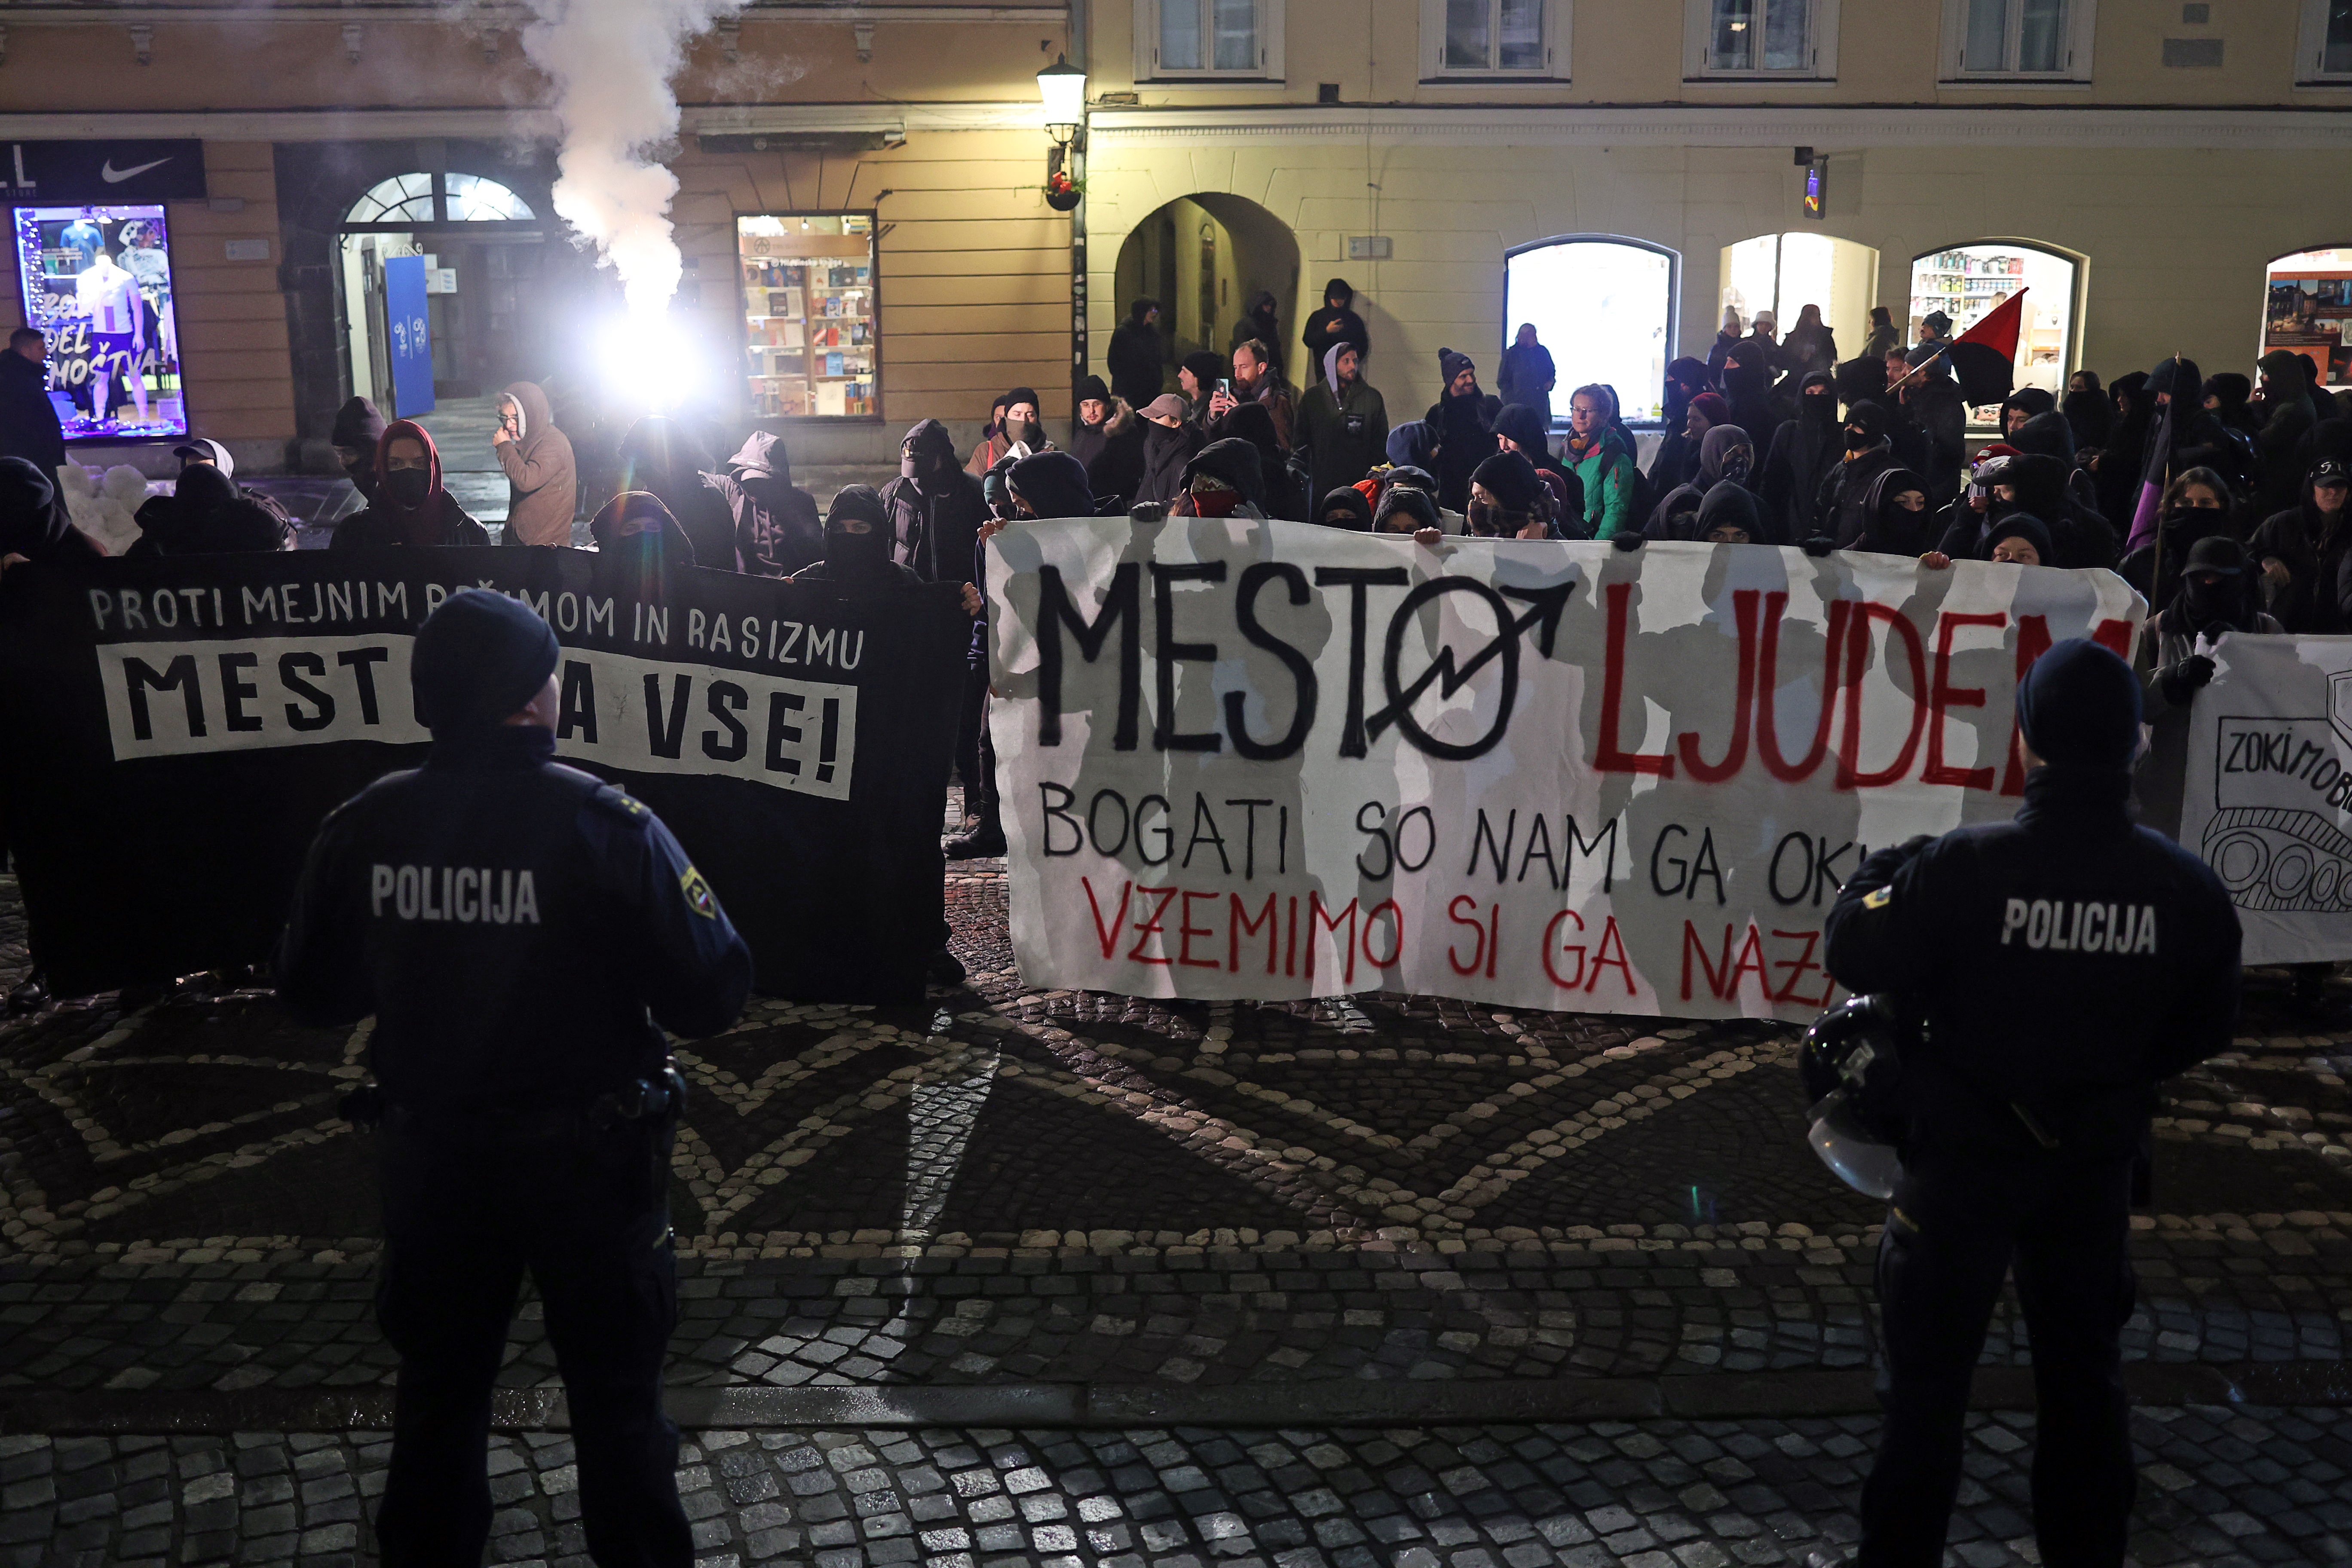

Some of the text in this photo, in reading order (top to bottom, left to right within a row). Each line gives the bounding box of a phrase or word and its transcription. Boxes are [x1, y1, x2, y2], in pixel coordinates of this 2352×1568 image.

[0, 144, 36, 188] L
[43, 323, 92, 354] DEL
[47, 341, 157, 392] MOŠTVA
[88, 585, 224, 630] PROTI
[242, 581, 409, 625] MEJNIM
[634, 602, 668, 645] IN
[688, 608, 864, 670] RASIZMU
[1037, 560, 1521, 761] MESTO
[122, 647, 431, 741] MEST
[643, 673, 840, 784] VSE!
[1038, 781, 1867, 906] BOGATI SO NAM GA OK
[372, 864, 541, 924] POLICIJA
[2000, 897, 2156, 954] POLICIJA
[1081, 876, 1837, 1008] VZEMIMO SI GA NAZ
